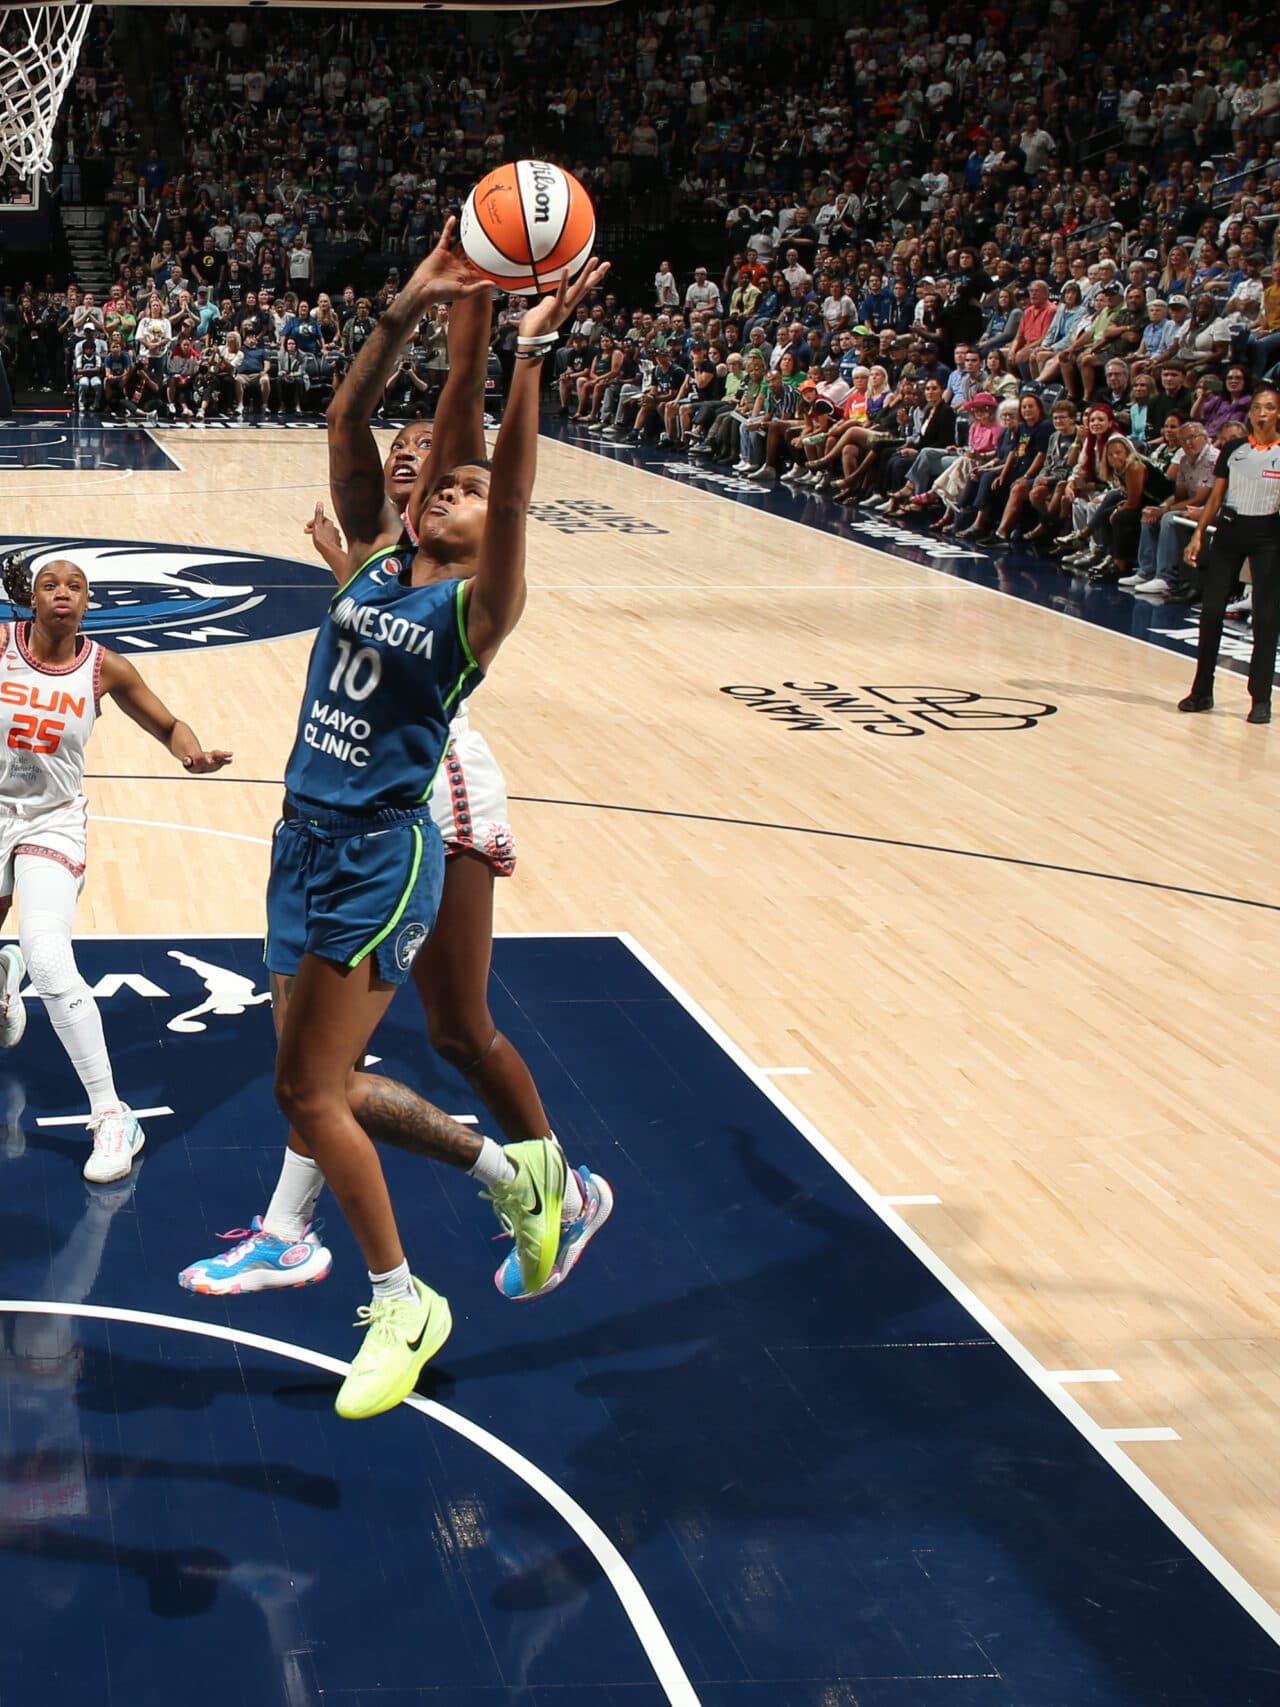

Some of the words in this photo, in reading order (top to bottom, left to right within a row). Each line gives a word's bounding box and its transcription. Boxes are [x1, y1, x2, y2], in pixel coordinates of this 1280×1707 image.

[331, 596, 434, 660] MINNESOTA
[329, 639, 382, 701] 10
[0, 681, 86, 719] SUN
[310, 699, 372, 741] MAYO
[720, 685, 845, 733] MAYO
[782, 681, 926, 738] CLINIC
[7, 713, 66, 754] 25
[304, 723, 372, 768] CLINIC
